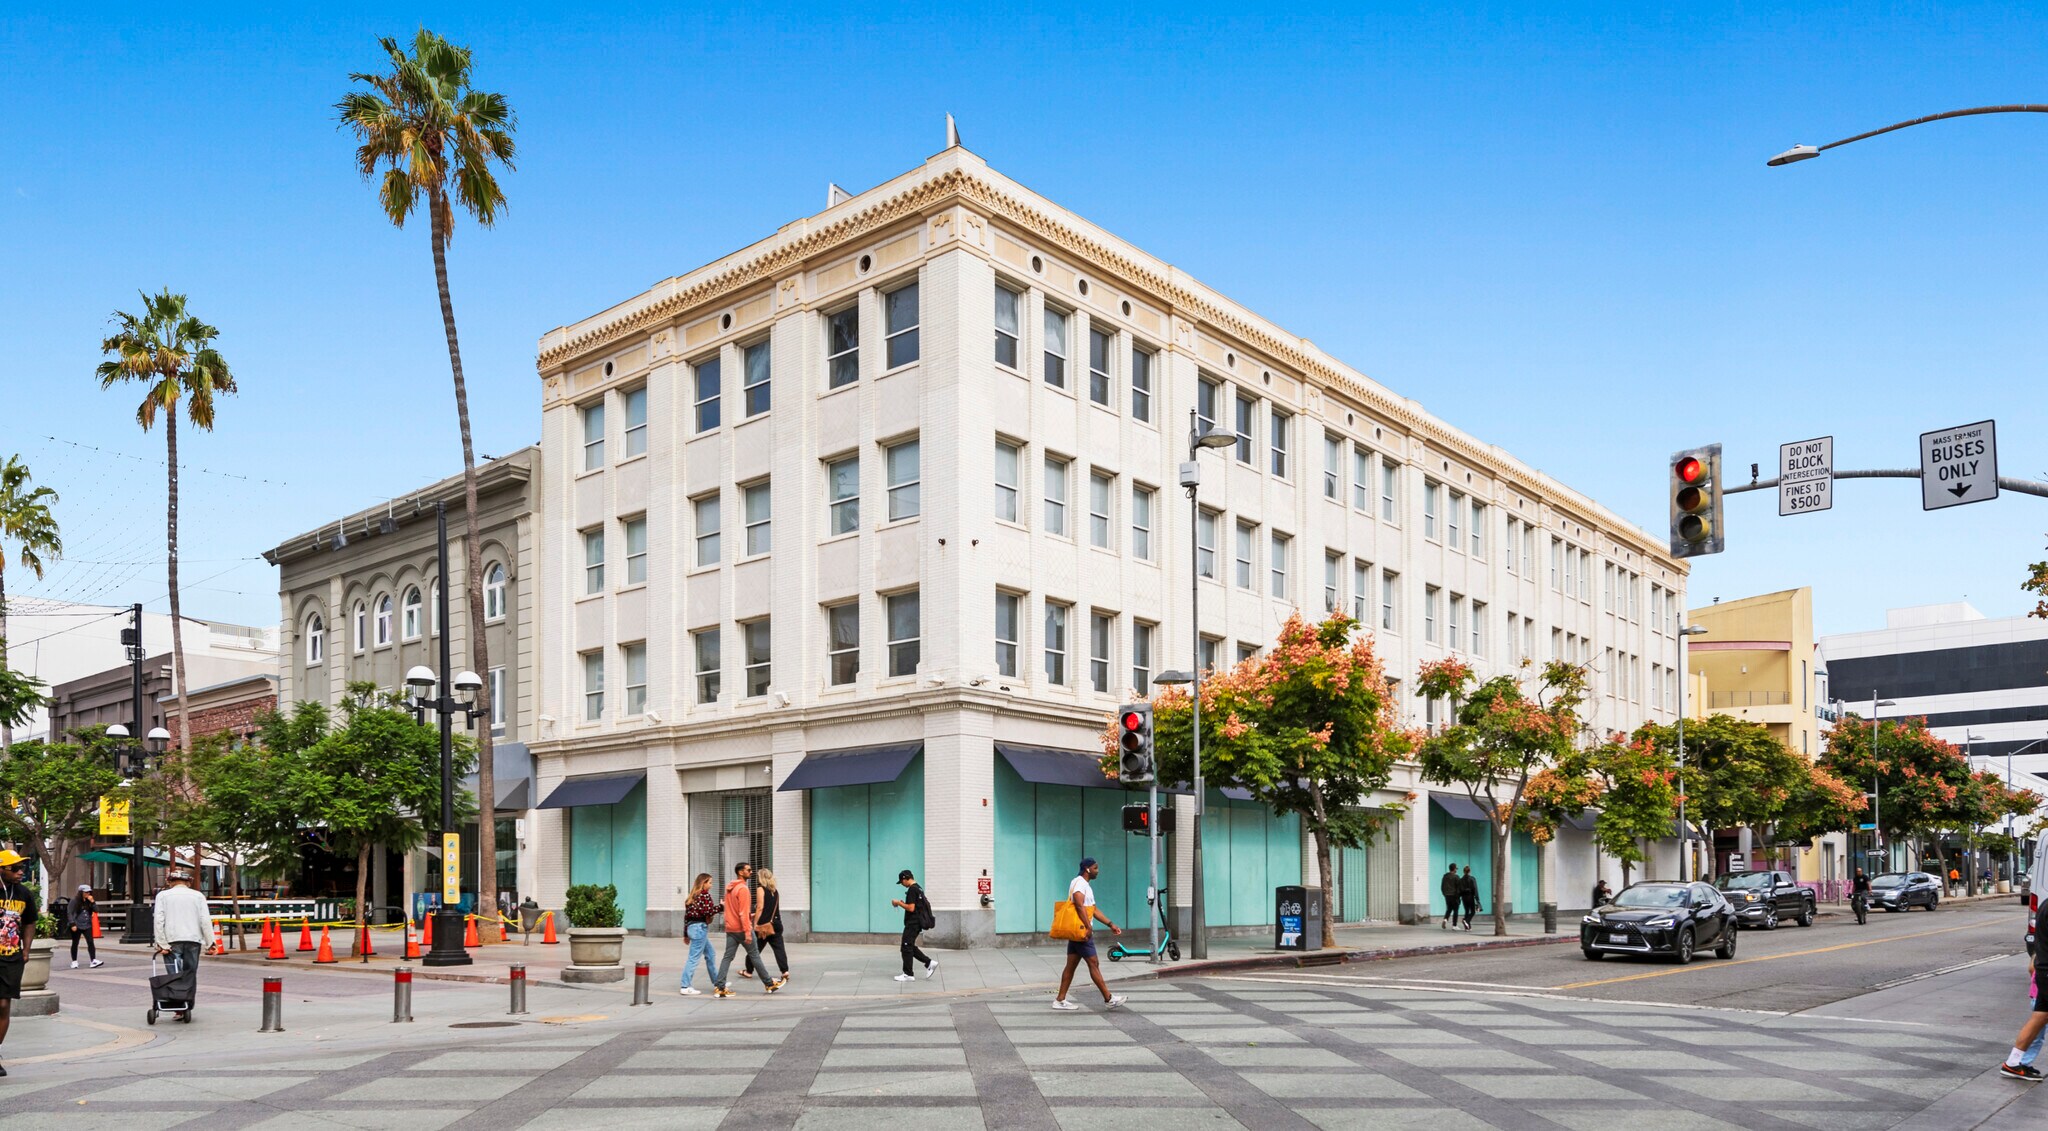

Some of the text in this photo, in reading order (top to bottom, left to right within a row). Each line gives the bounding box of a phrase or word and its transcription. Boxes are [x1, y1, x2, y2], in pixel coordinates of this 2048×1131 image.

[1933, 429, 1982, 445] MASS TRANSIT
[1790, 442, 1823, 457] DO NOT
[1931, 440, 1985, 463] BUSES
[1788, 454, 1824, 471] BLOCK
[1939, 460, 1979, 481] ONLY
[1783, 467, 1830, 481] INTERSECTION
[1786, 482, 1826, 496] FINES TO
[1140, 811, 1148, 827] 4
